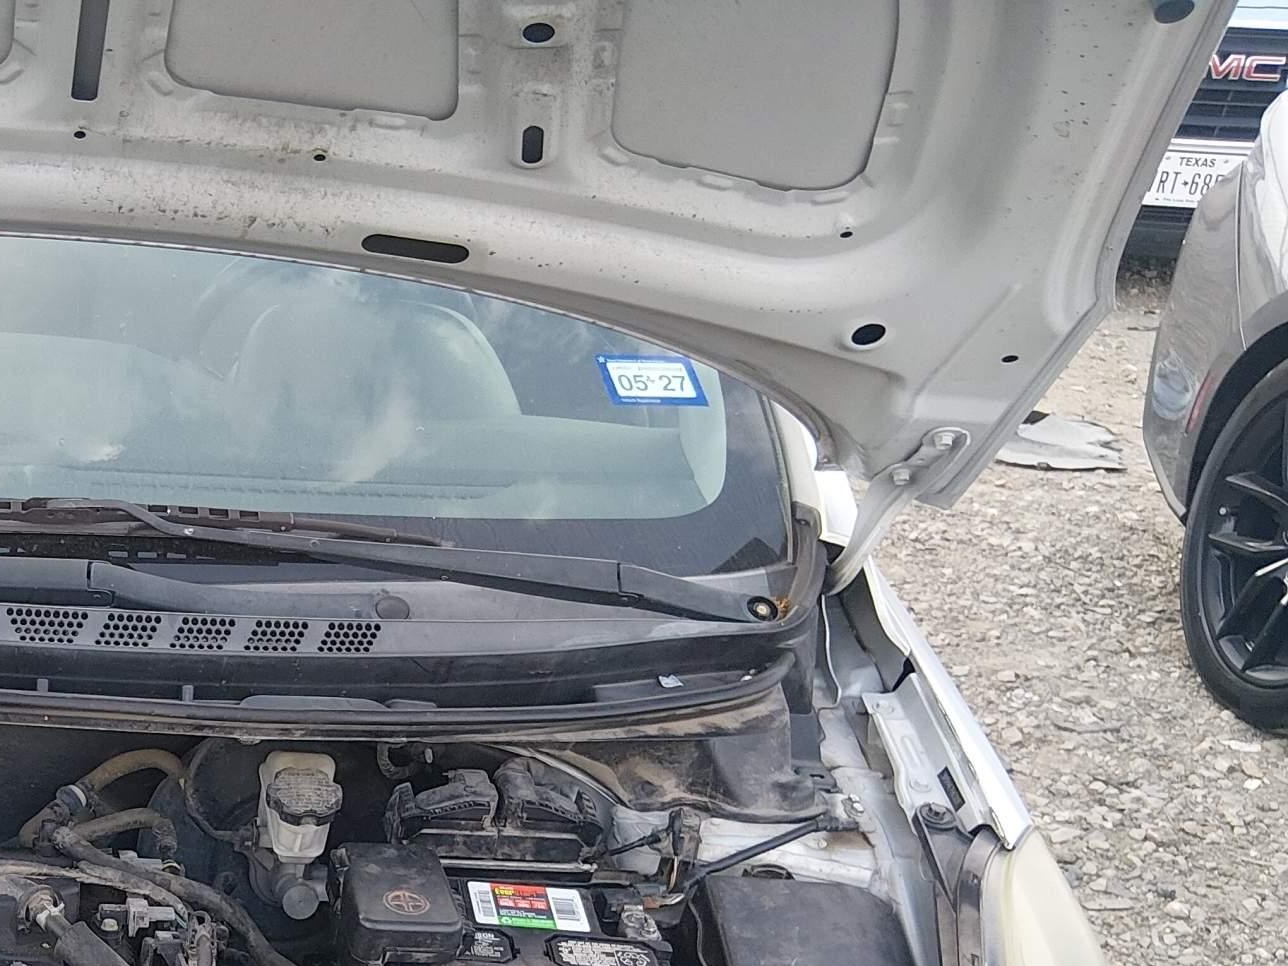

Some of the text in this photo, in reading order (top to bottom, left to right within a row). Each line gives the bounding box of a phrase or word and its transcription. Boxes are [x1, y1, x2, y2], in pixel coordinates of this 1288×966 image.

[1209, 54, 1287, 81] MC
[1179, 156, 1216, 168] TEXAS
[617, 374, 686, 392] 05 27
